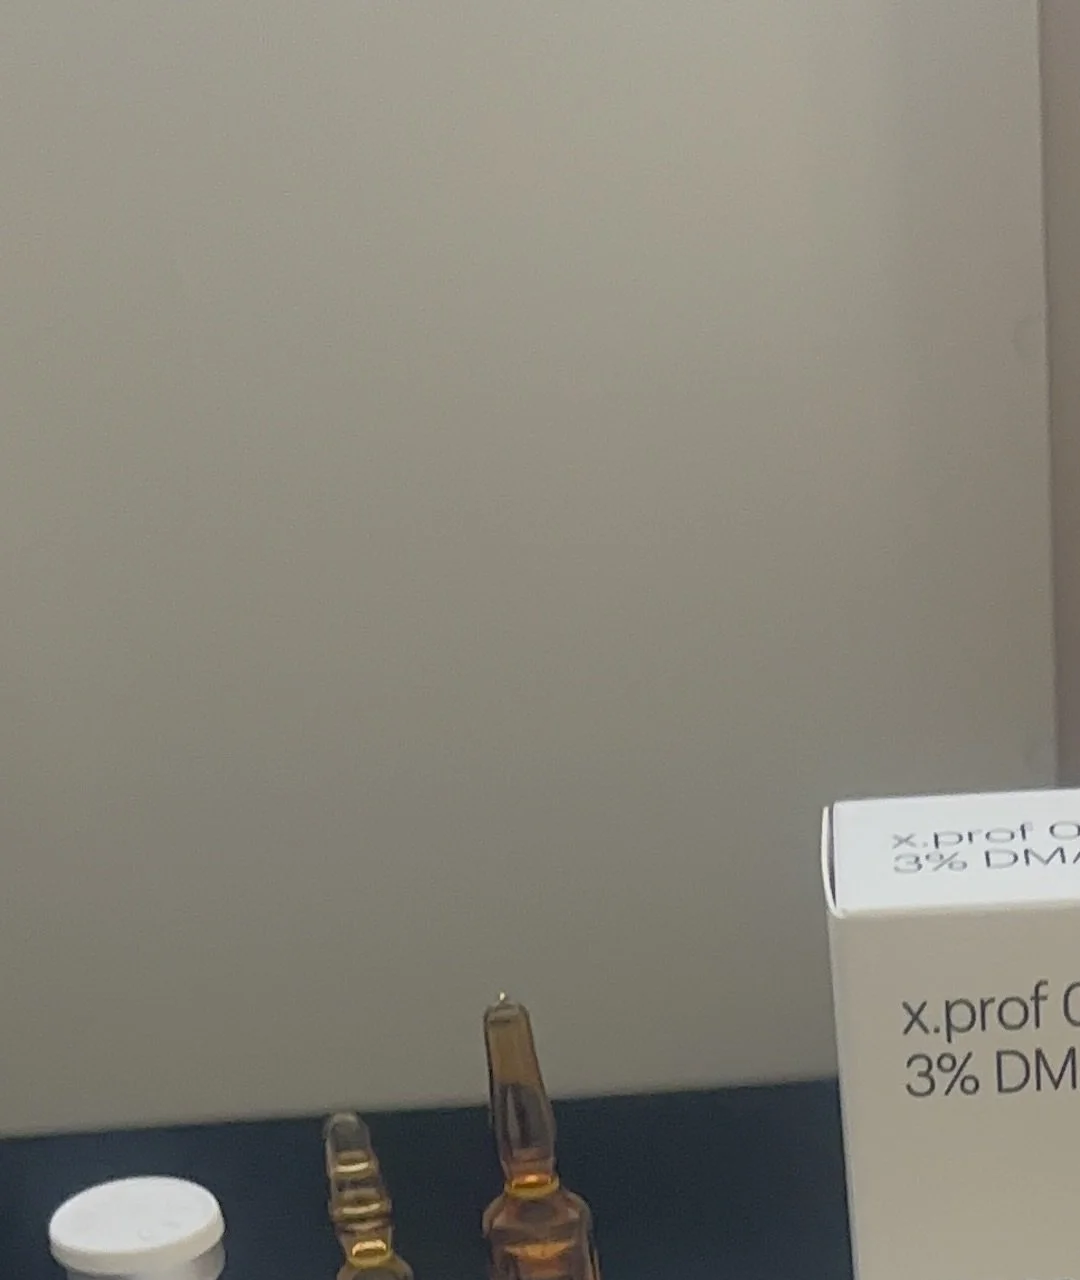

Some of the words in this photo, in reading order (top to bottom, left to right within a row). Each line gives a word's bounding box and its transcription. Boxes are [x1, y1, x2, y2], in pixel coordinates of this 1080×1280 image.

[891, 822, 1034, 850] x.prof
[892, 851, 968, 874] 3%
[901, 980, 1050, 1043] x.prof
[904, 1051, 980, 1097] 3%
